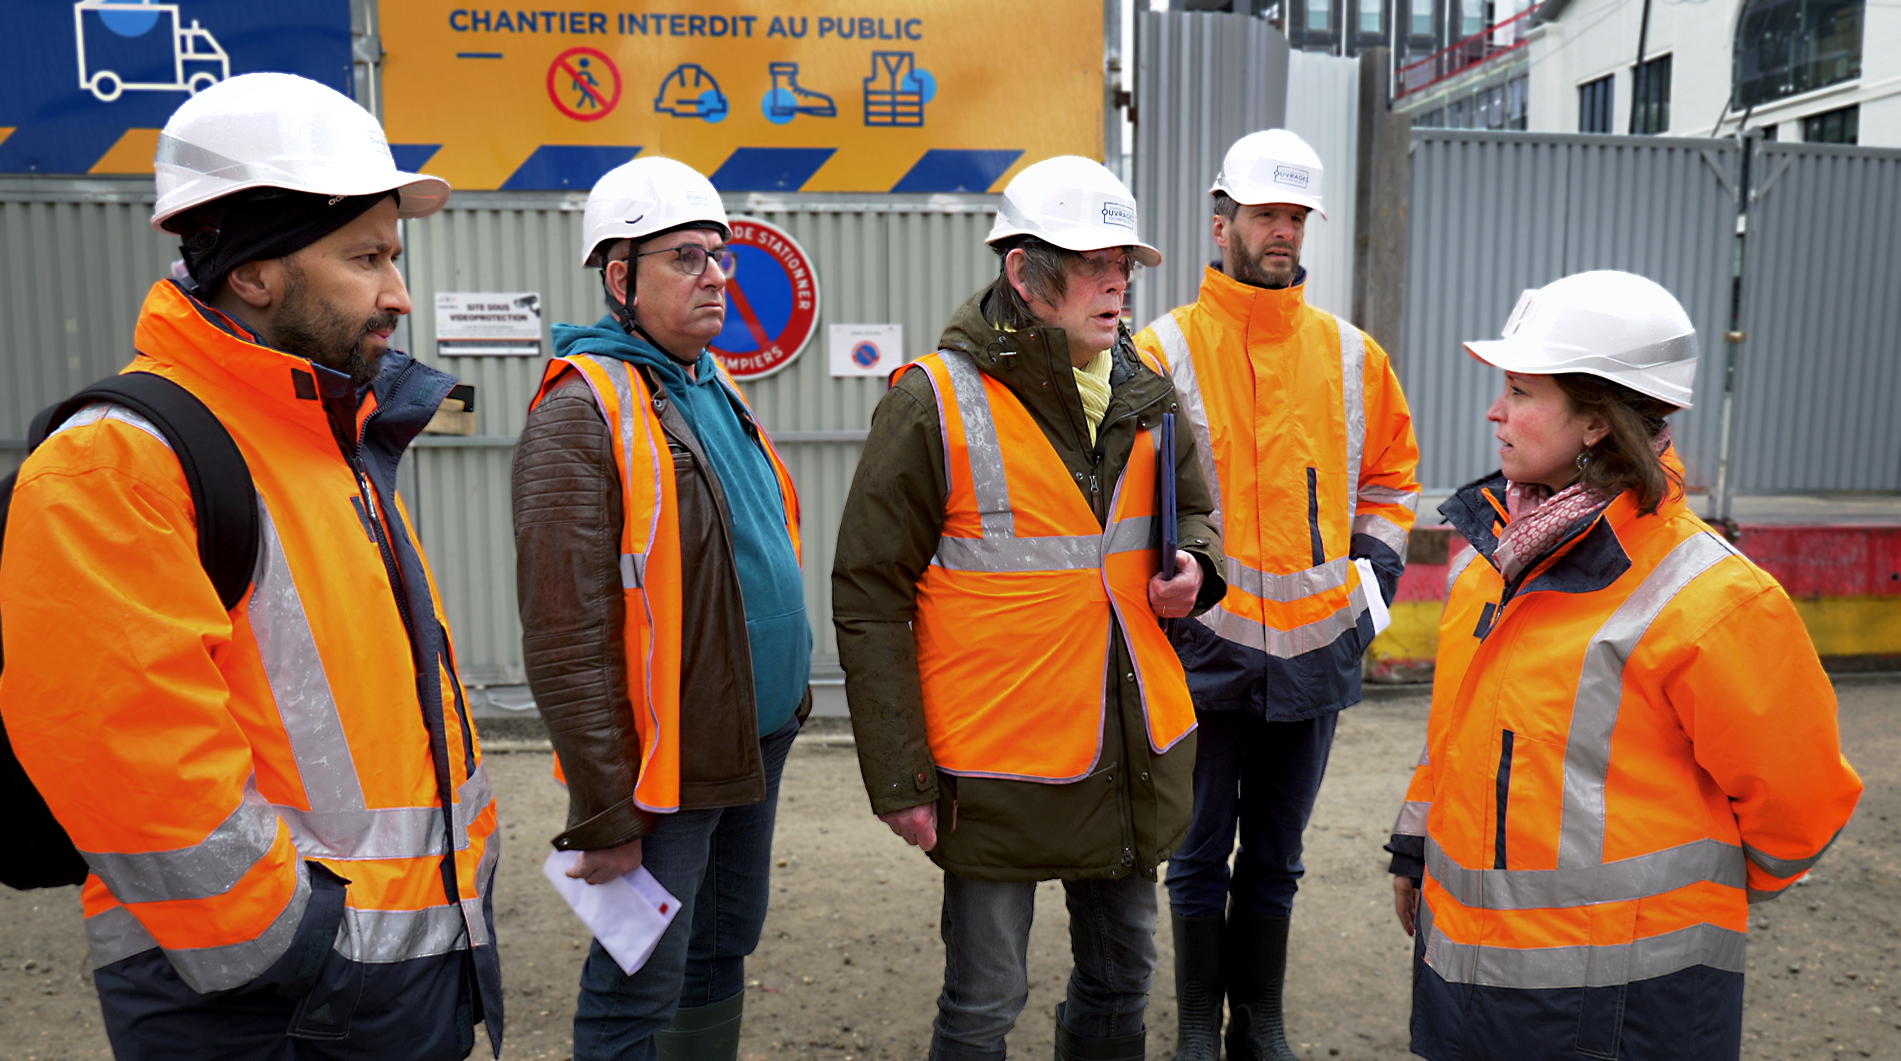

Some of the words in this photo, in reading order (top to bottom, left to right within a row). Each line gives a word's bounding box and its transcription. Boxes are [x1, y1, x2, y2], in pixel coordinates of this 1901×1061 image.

[449, 9, 608, 35] CHANTIER
[618, 13, 757, 38] INTERDIT
[766, 16, 808, 39] AU
[818, 17, 923, 41] PUBLIC
[734, 226, 754, 240] DE
[757, 231, 811, 310] STATIONNER
